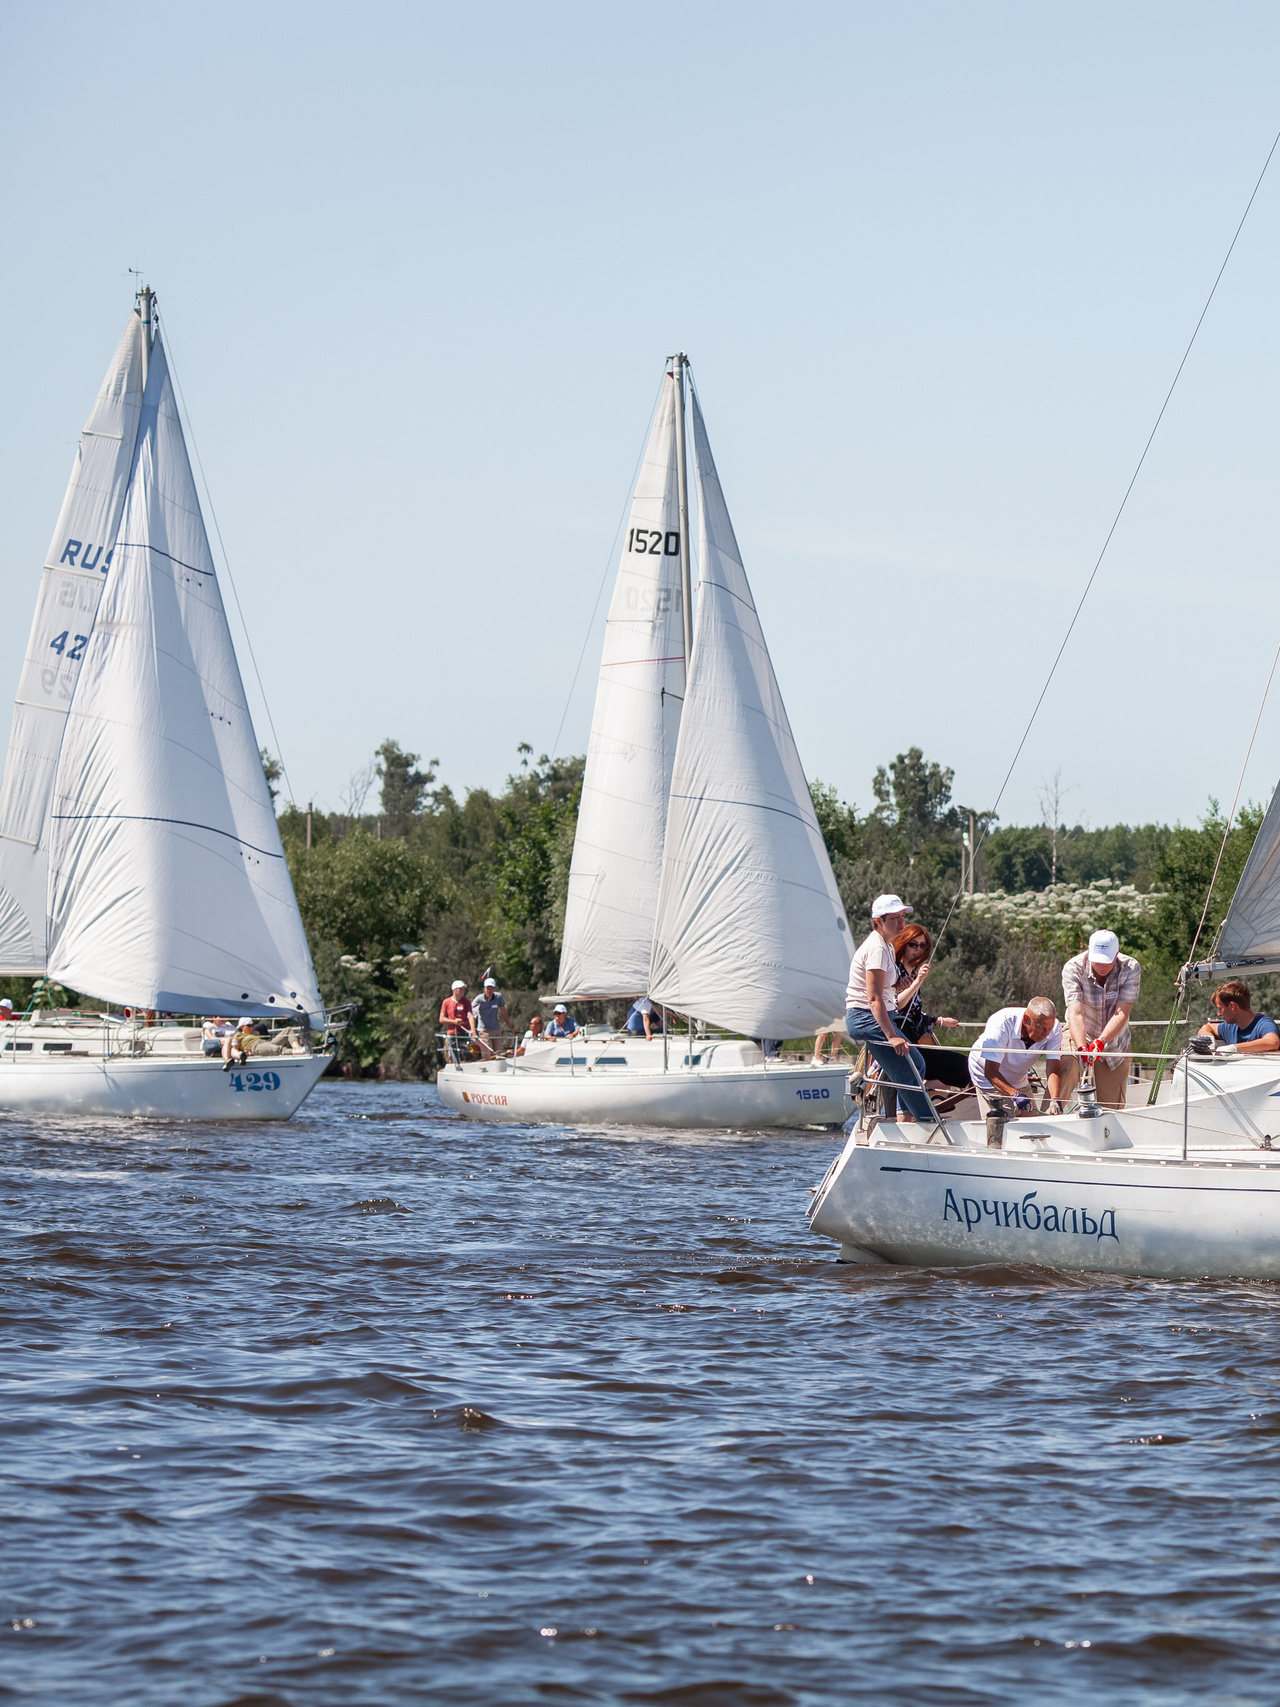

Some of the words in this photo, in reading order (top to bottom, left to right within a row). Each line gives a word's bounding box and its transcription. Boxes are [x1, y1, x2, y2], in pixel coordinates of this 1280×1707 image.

[628, 527, 681, 557] 1520
[59, 538, 114, 575] RUS
[228, 1071, 281, 1092] 429
[796, 1088, 830, 1100] 1520
[470, 1093, 508, 1106] РОССИЯ
[943, 1188, 1120, 1244] Арчибальд
